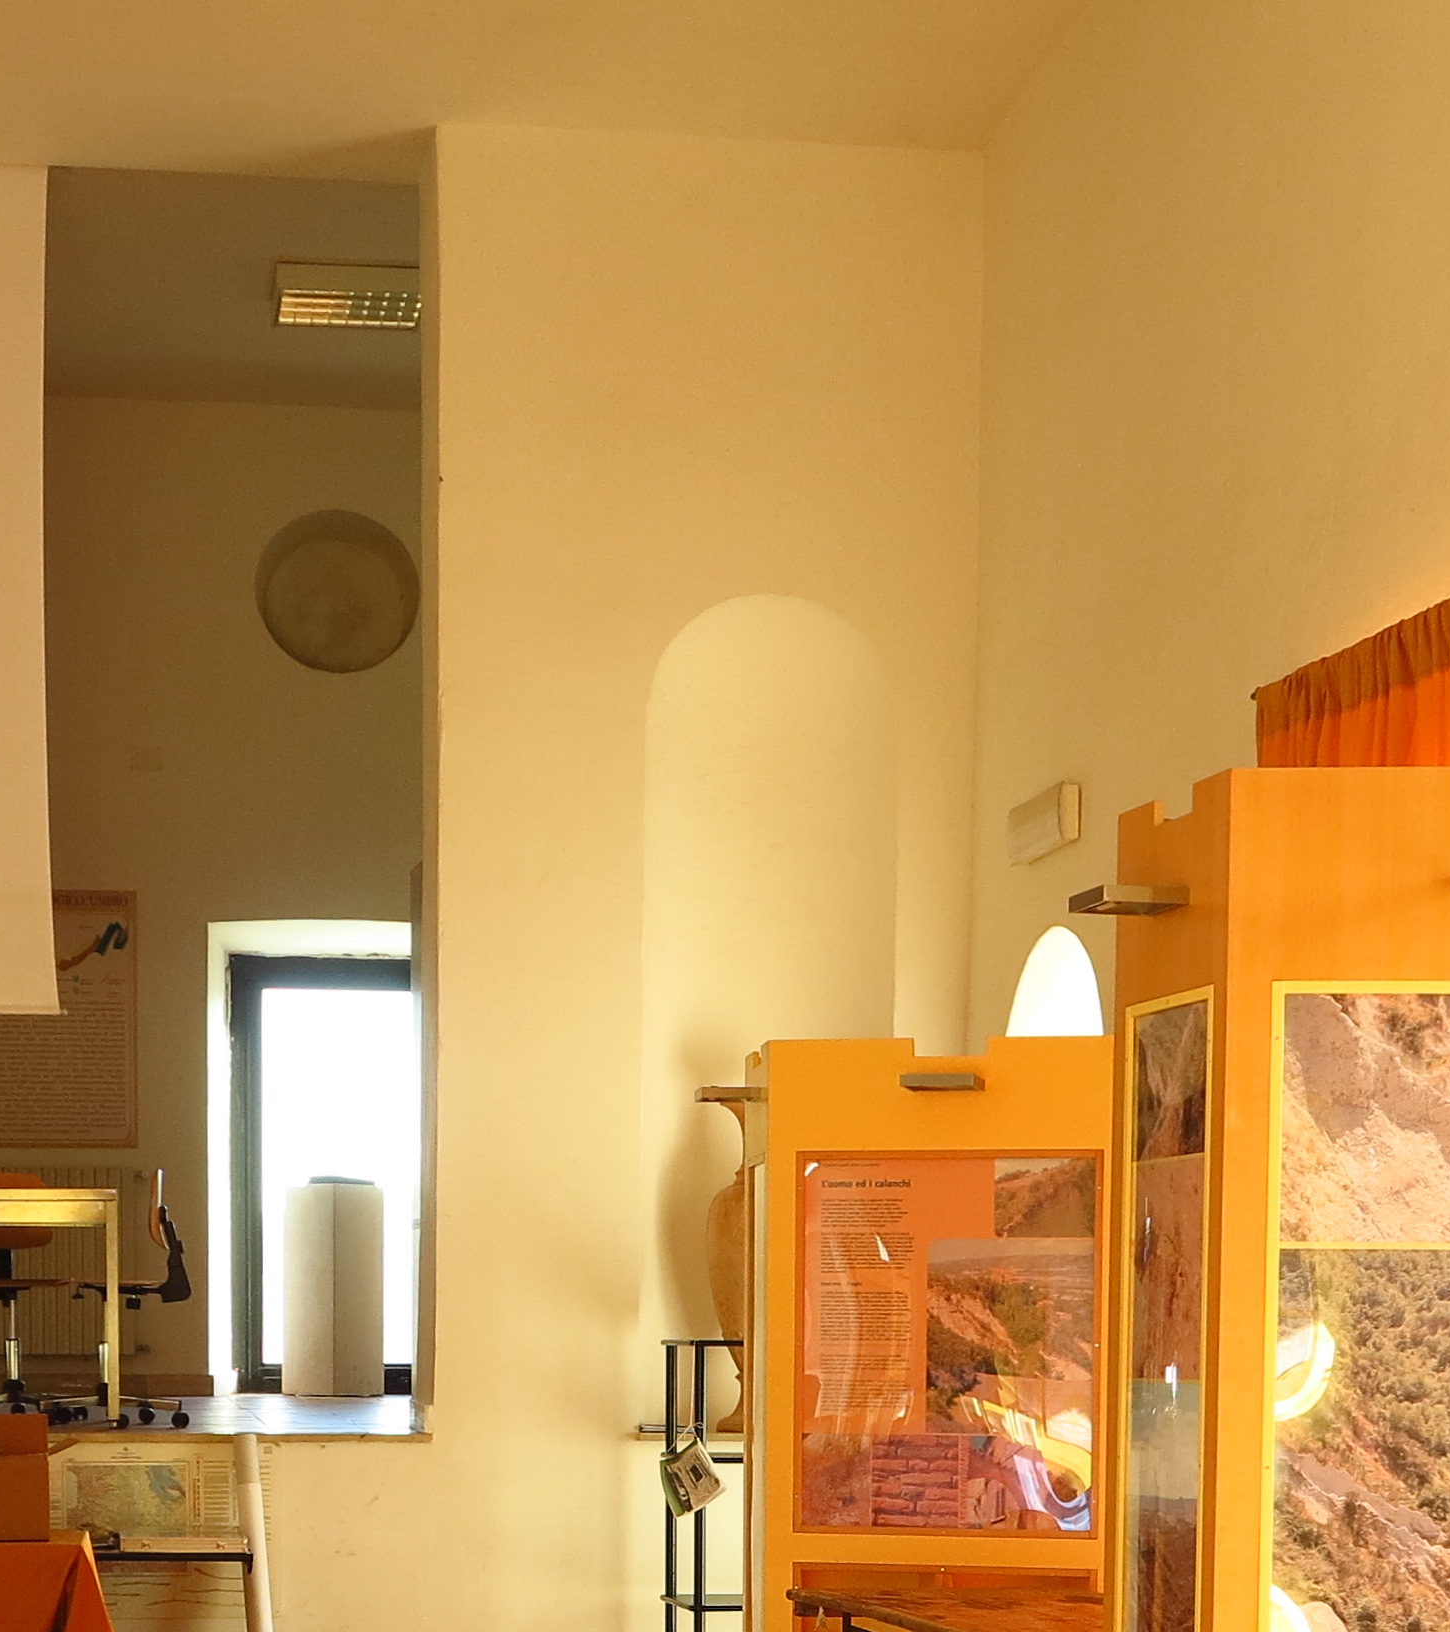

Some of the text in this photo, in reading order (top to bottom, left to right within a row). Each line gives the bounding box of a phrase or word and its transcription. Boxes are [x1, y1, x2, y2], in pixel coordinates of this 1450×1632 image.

[821, 1179, 853, 1188] L'uomo
[855, 1179, 867, 1188] ed
[874, 1179, 911, 1188] calanchi
